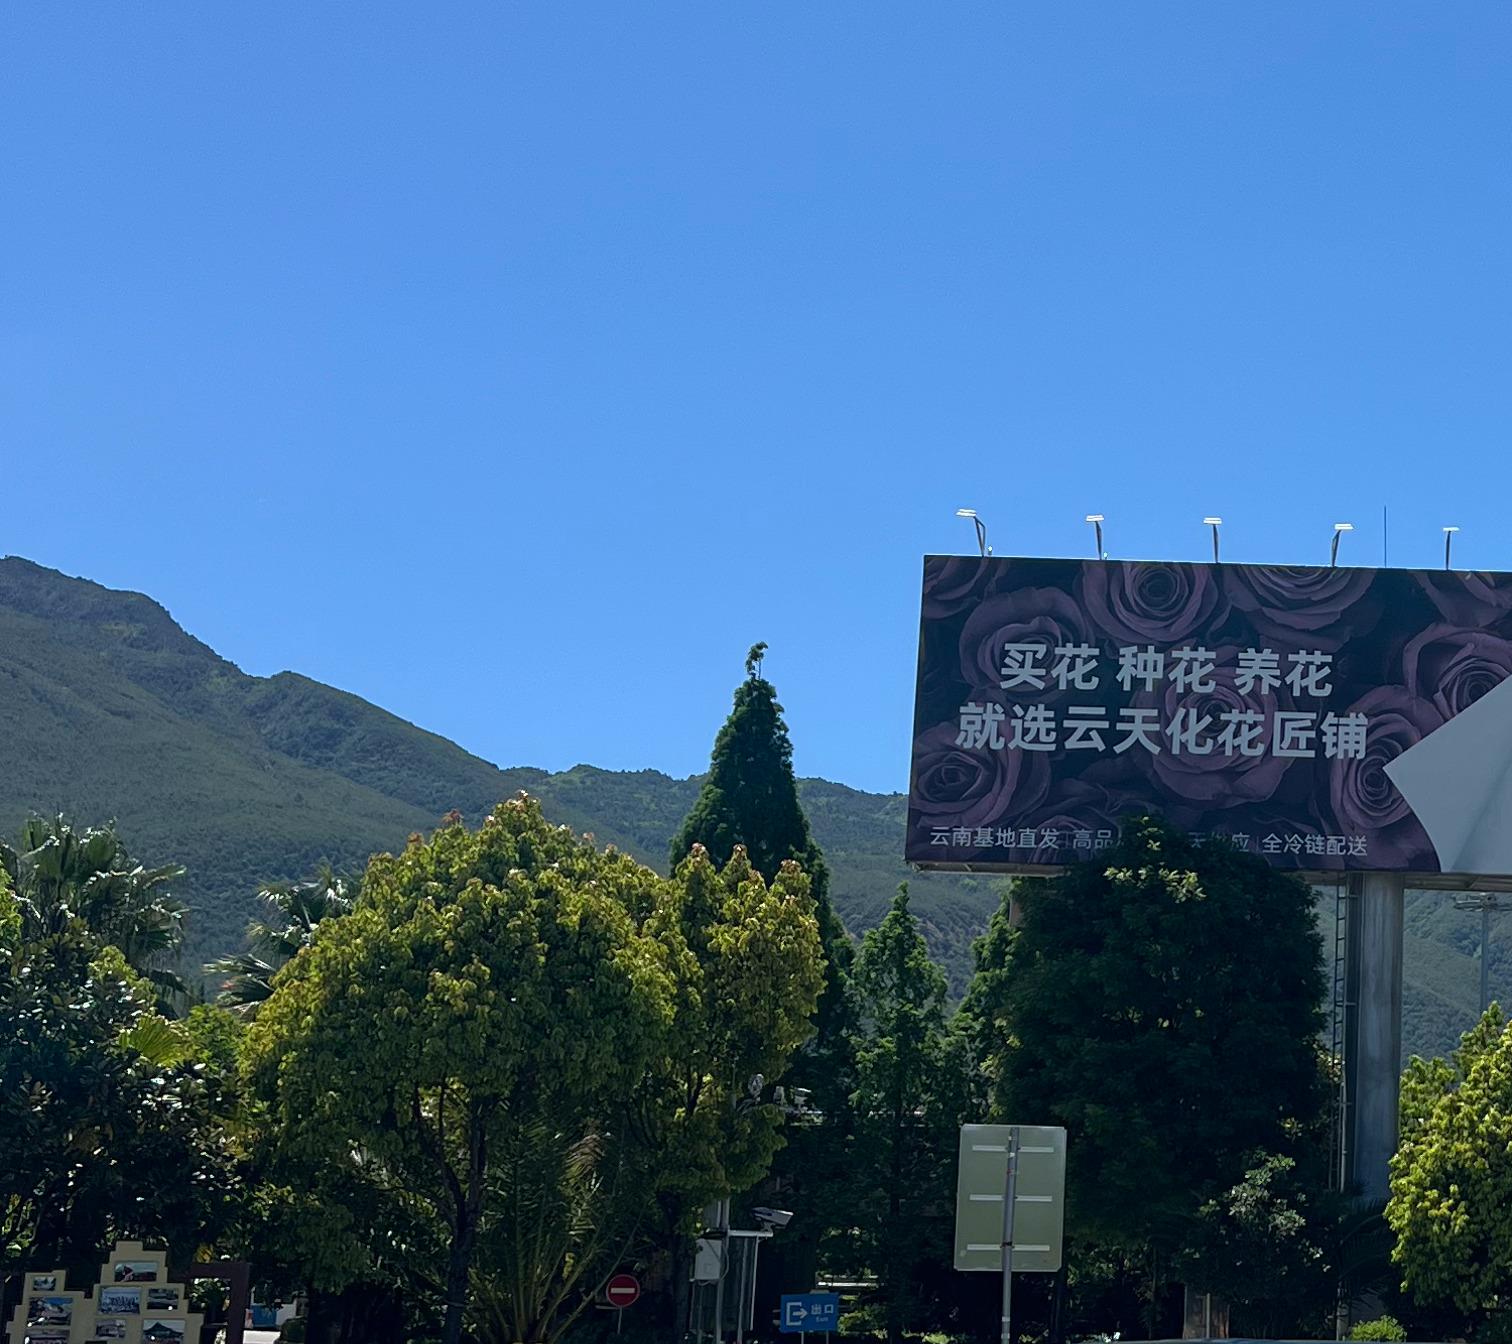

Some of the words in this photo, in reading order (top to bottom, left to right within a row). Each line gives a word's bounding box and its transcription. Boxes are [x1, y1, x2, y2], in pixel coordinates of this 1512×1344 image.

[999, 642, 1100, 691] 买花
[1116, 644, 1217, 694] 种花
[1235, 647, 1333, 697] 养花
[954, 701, 1369, 760] 就选云天化花匠铺
[929, 825, 1060, 850] 云南基地直发
[1261, 832, 1369, 857] 全冷链配送
[811, 1304, 834, 1315] 出口
